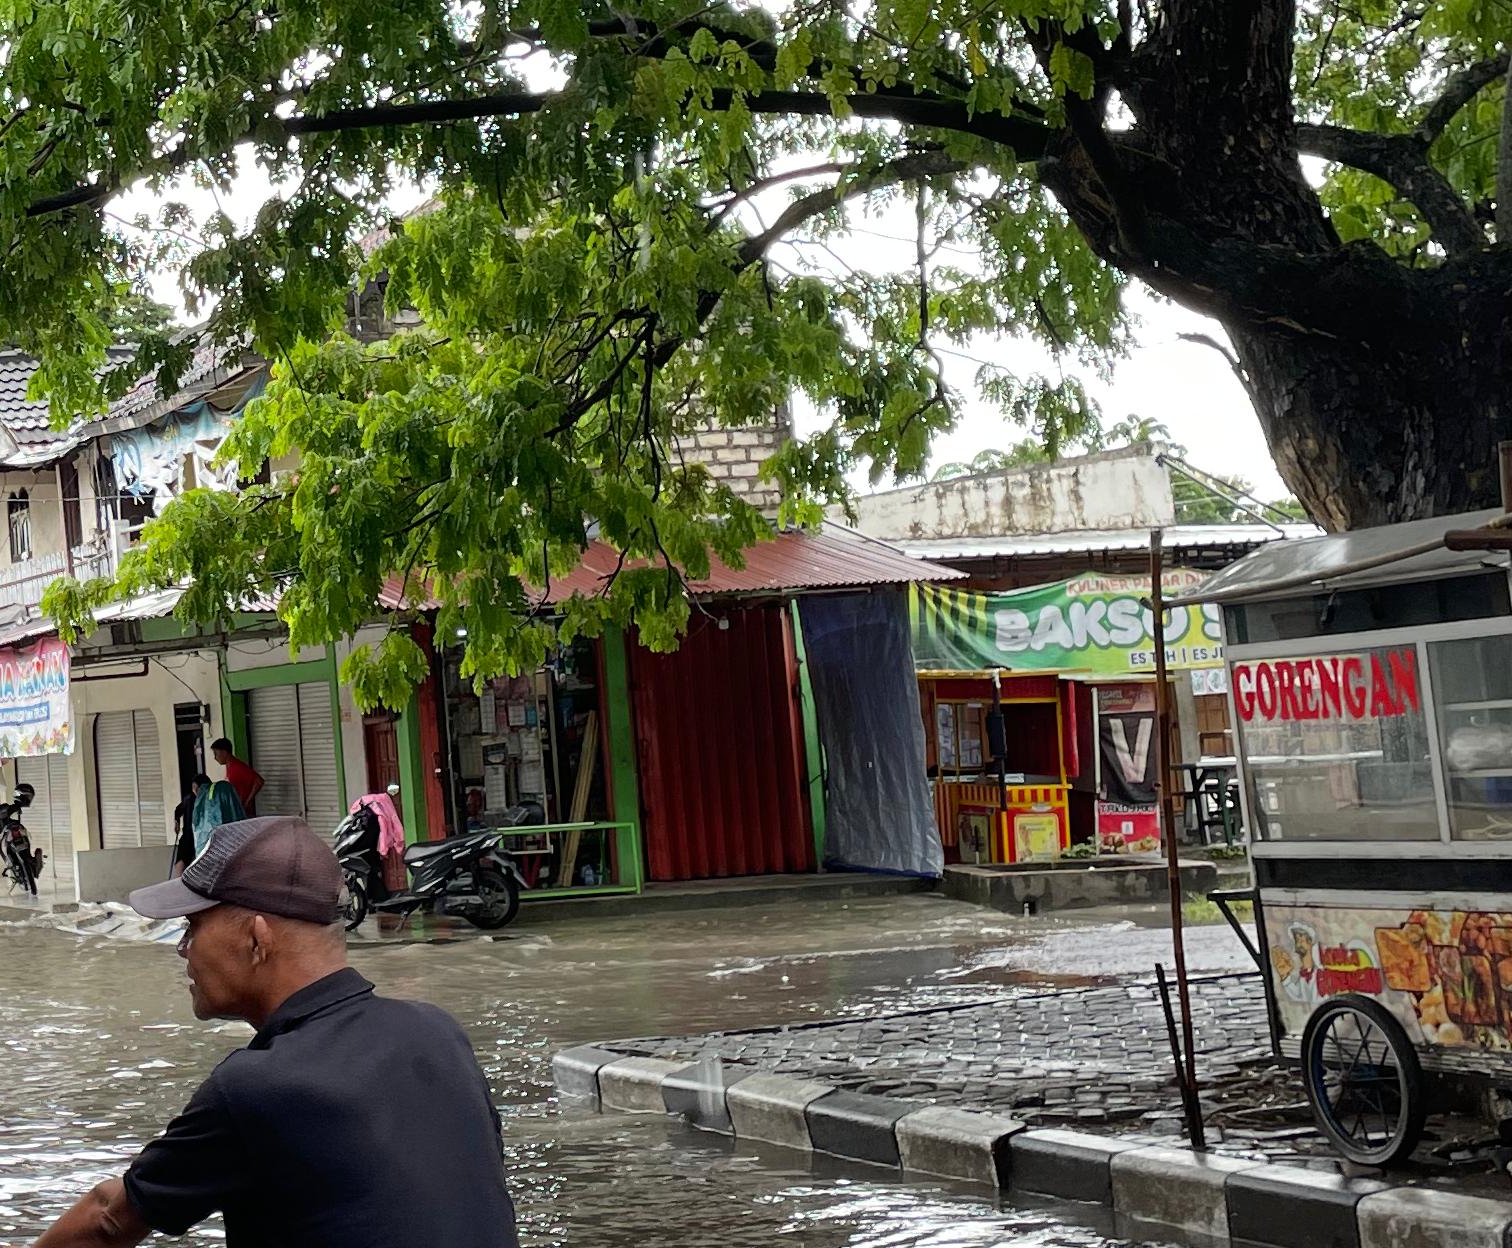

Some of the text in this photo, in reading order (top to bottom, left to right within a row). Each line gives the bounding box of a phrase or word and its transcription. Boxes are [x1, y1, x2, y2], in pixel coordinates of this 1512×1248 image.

[1134, 574, 1179, 590] PAAR
[996, 598, 1188, 651] BAKSO
[1131, 653, 1147, 665] ES
[1148, 650, 1176, 663] TH
[1193, 648, 1208, 661] ES
[1233, 648, 1420, 723] GORENGAN
